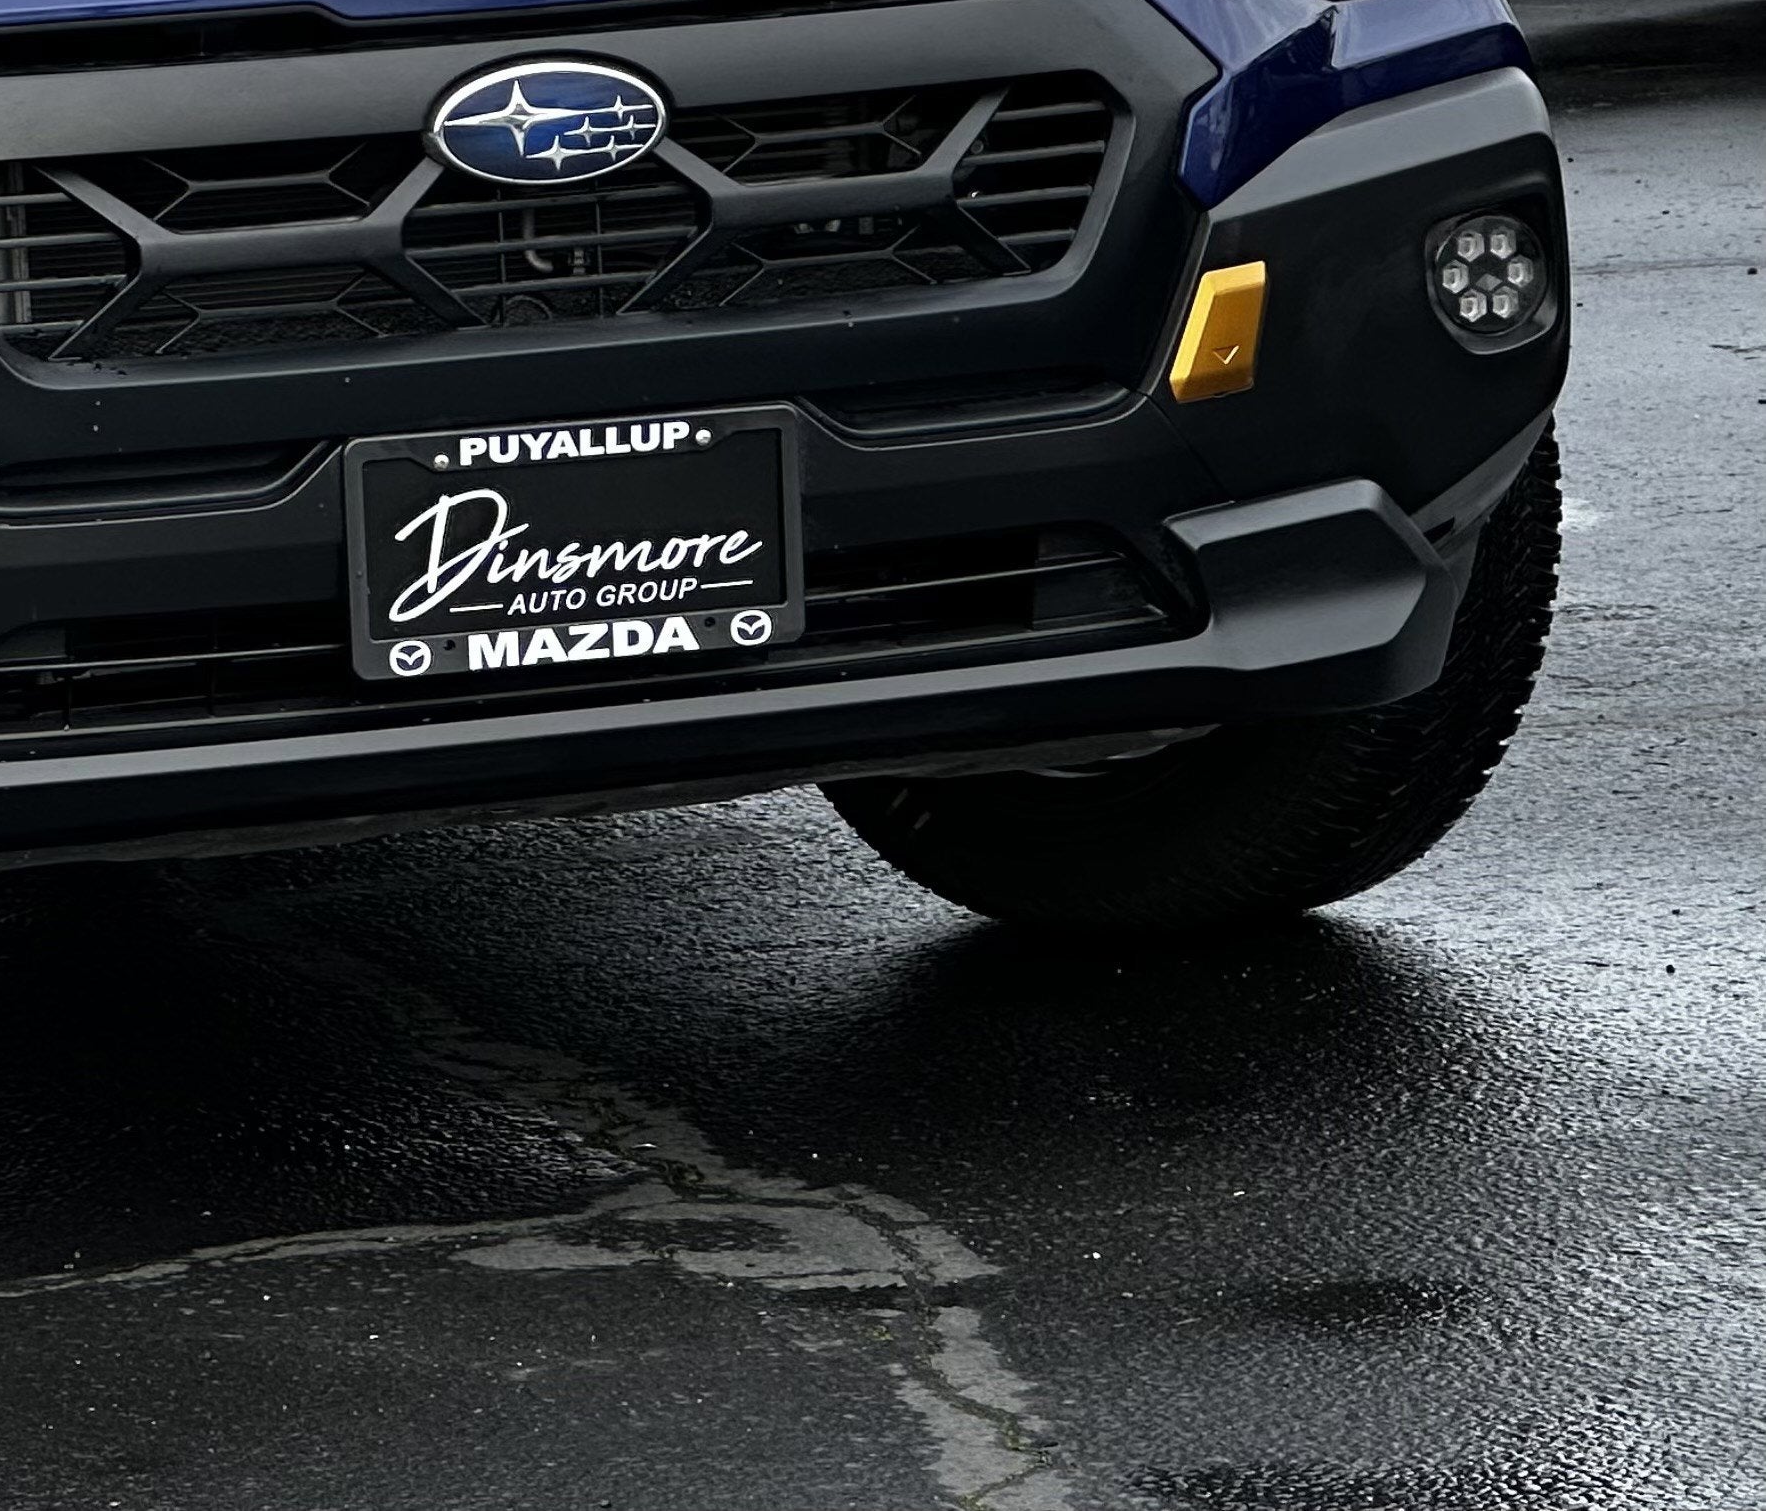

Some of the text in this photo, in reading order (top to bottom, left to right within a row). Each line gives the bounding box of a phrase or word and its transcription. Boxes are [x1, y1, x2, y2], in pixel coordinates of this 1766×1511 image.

[459, 421, 690, 466] PUYALLUP
[388, 488, 763, 623] Dinsmore
[507, 577, 698, 616] AUTO GROUP
[467, 616, 700, 671] MAZDA
